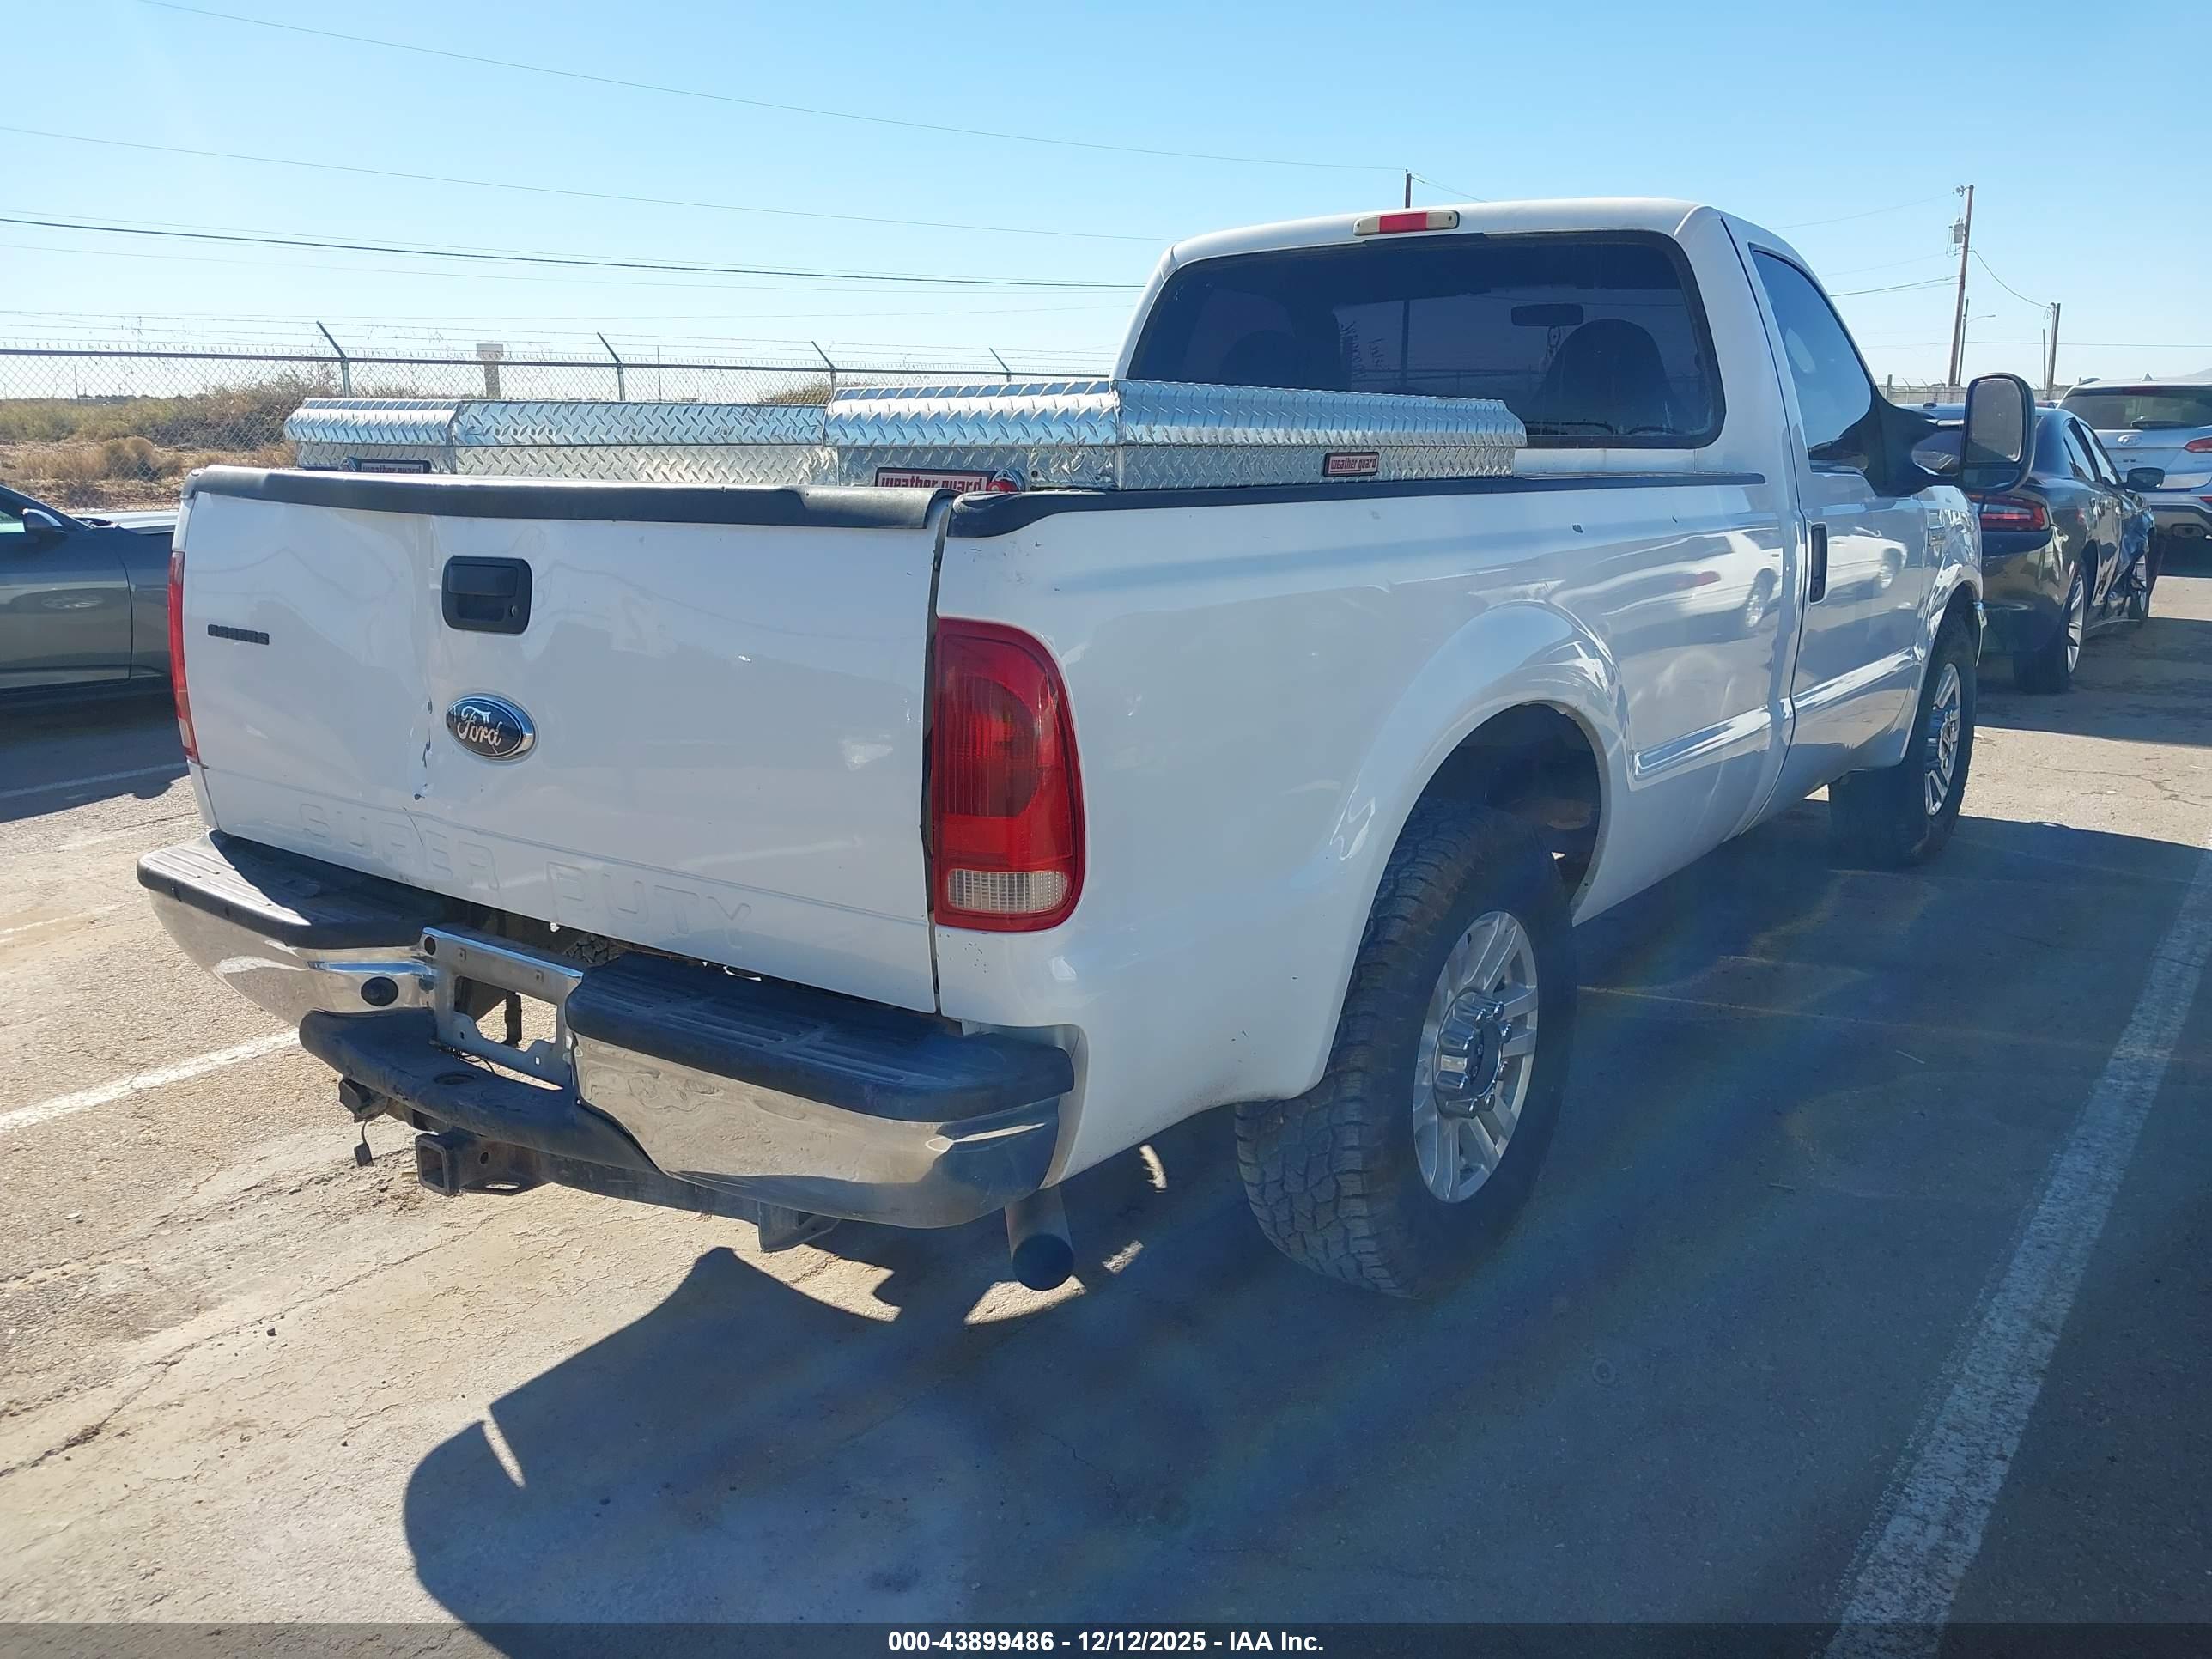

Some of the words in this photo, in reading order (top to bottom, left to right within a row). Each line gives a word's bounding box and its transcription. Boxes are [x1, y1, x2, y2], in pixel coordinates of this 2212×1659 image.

[1331, 457, 1358, 469] weather
[457, 705, 503, 747] Ford
[297, 802, 506, 908] SUPER
[545, 859, 752, 949] DUTY
